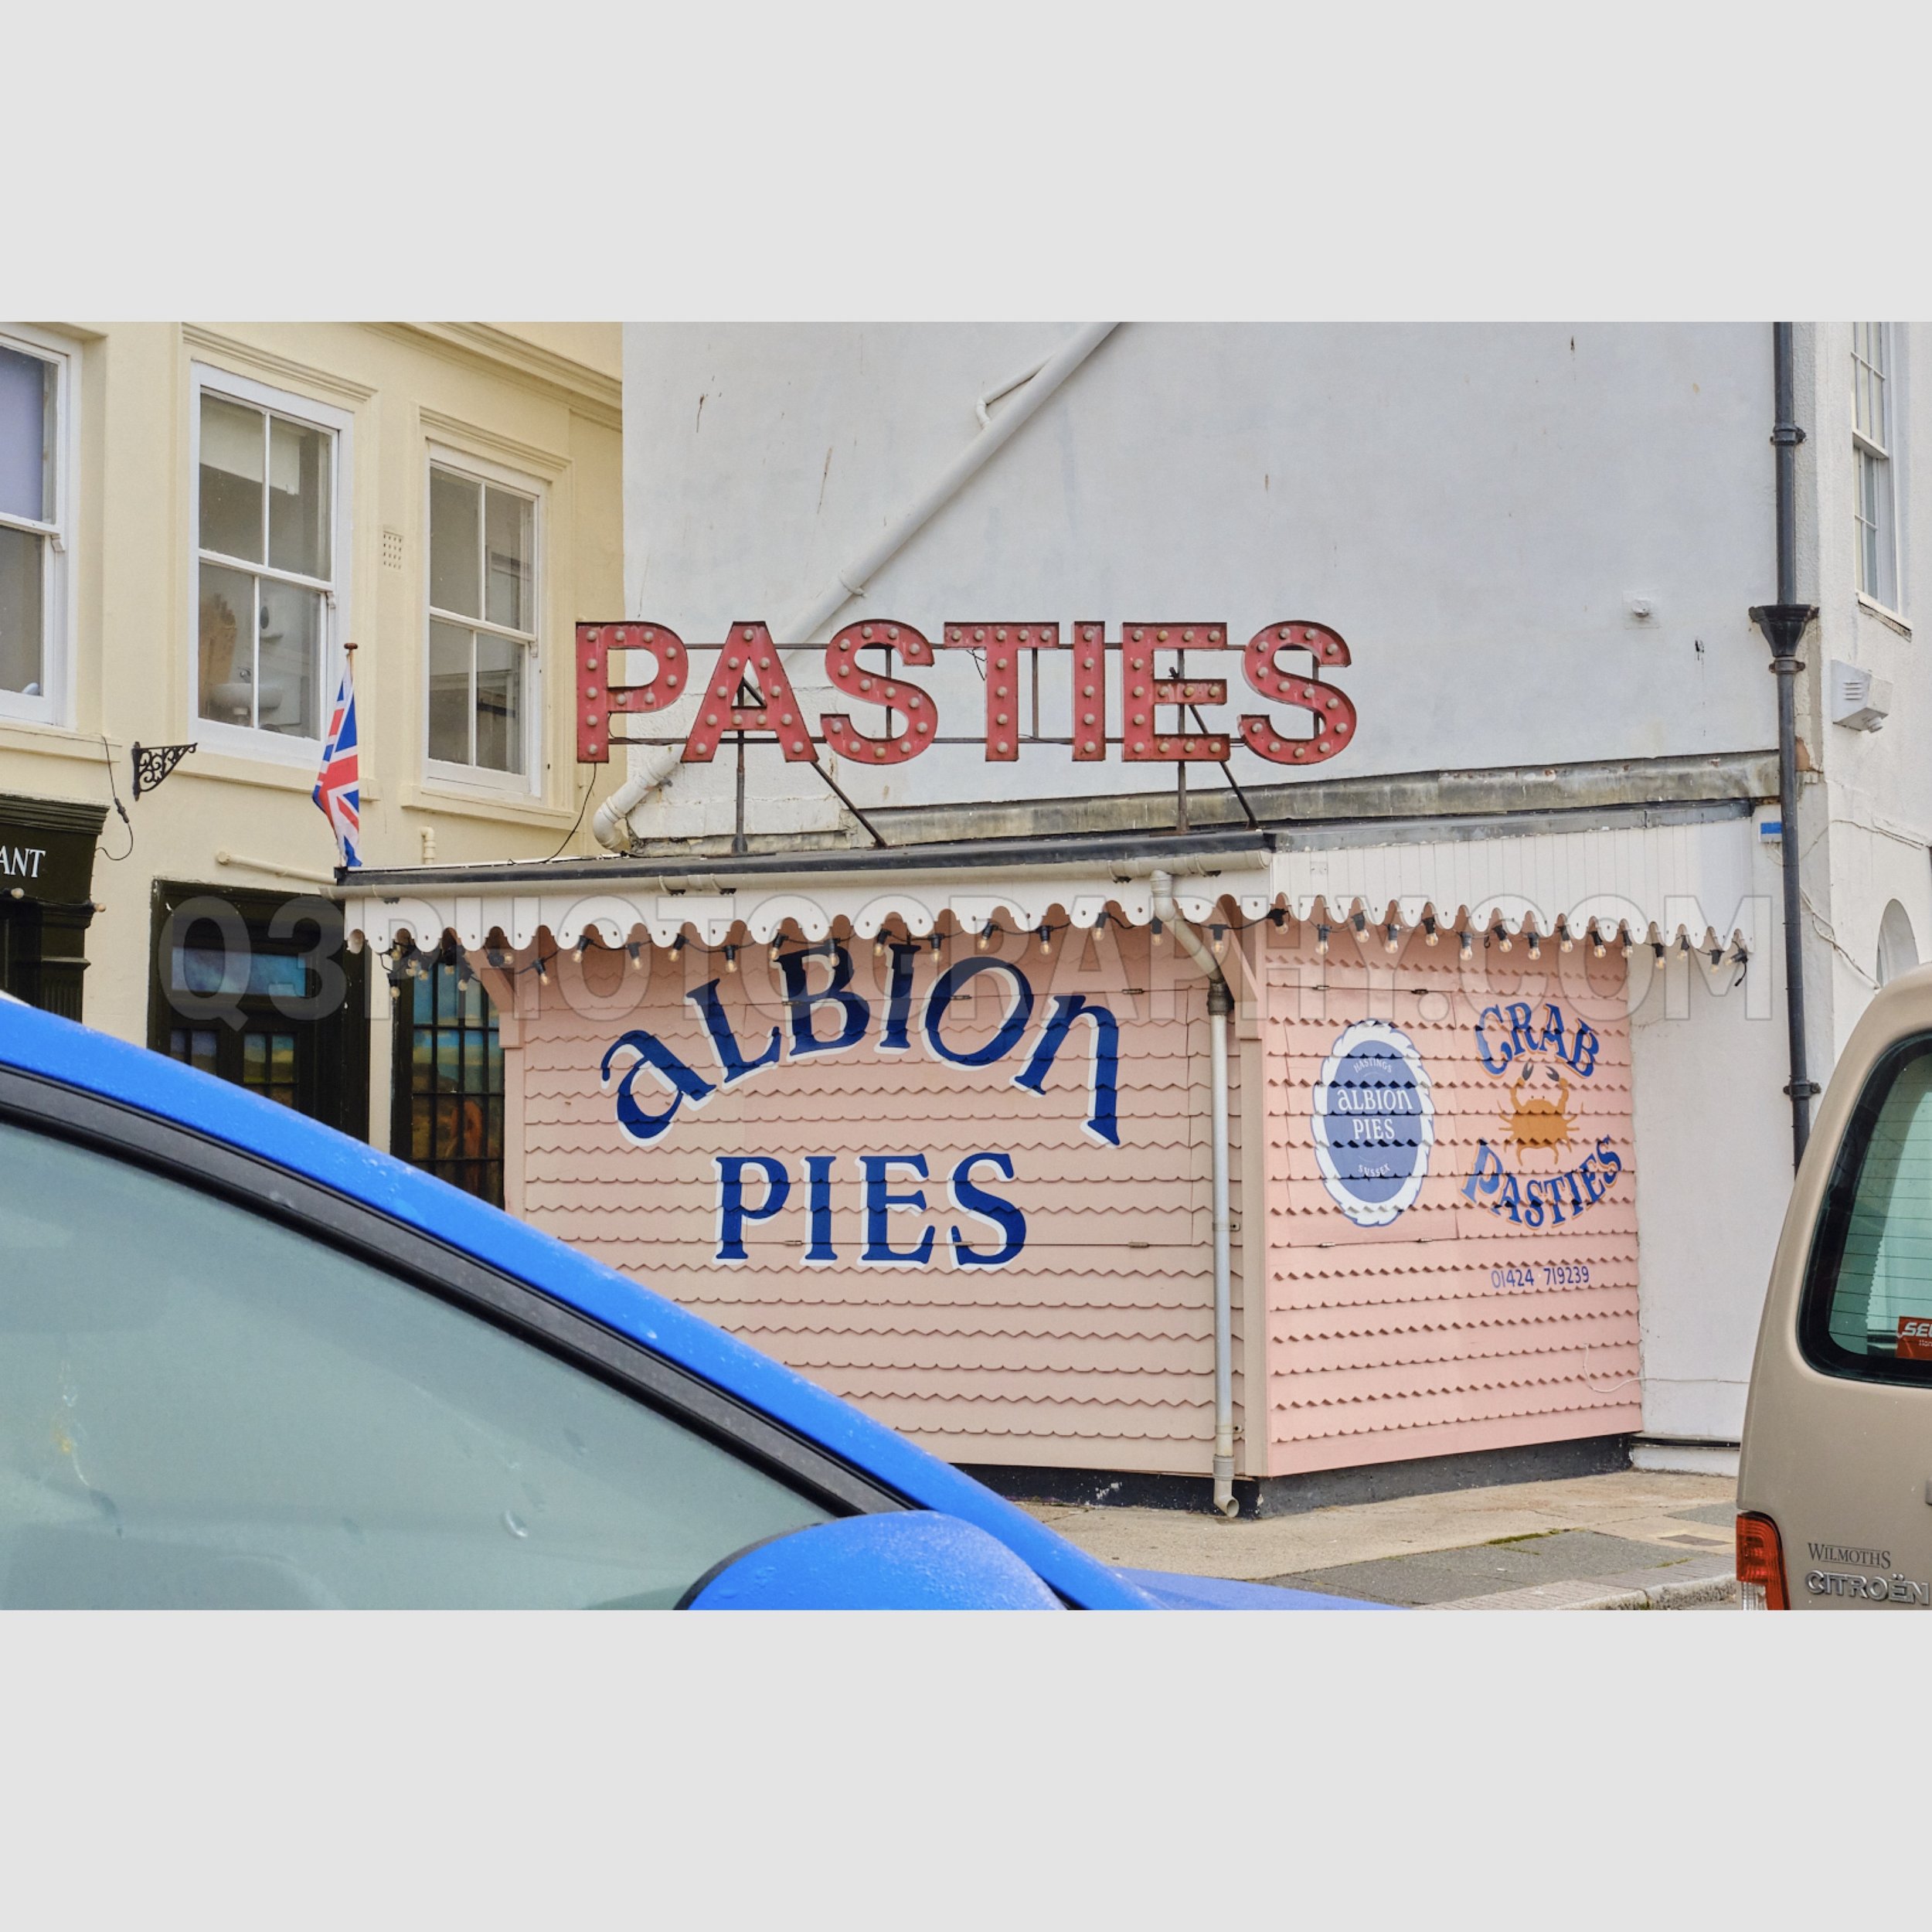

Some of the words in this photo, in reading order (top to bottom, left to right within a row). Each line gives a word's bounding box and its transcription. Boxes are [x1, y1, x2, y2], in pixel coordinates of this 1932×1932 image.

[576, 621, 1356, 765] PASTIES
[1476, 1002, 1600, 1077] CRAB
[1354, 1058, 1392, 1073] HASTINGS
[1352, 1118, 1395, 1140] PIES
[1358, 1163, 1391, 1177] SUSSEX
[1461, 1134, 1622, 1230] PASTIES
[713, 1152, 1027, 1270] PIES
[1491, 1268, 1534, 1288] 01424
[1543, 1265, 1590, 1285] 719239
[1902, 1322, 1932, 1337] SE
[1805, 1570, 1930, 1606] CITROËN
